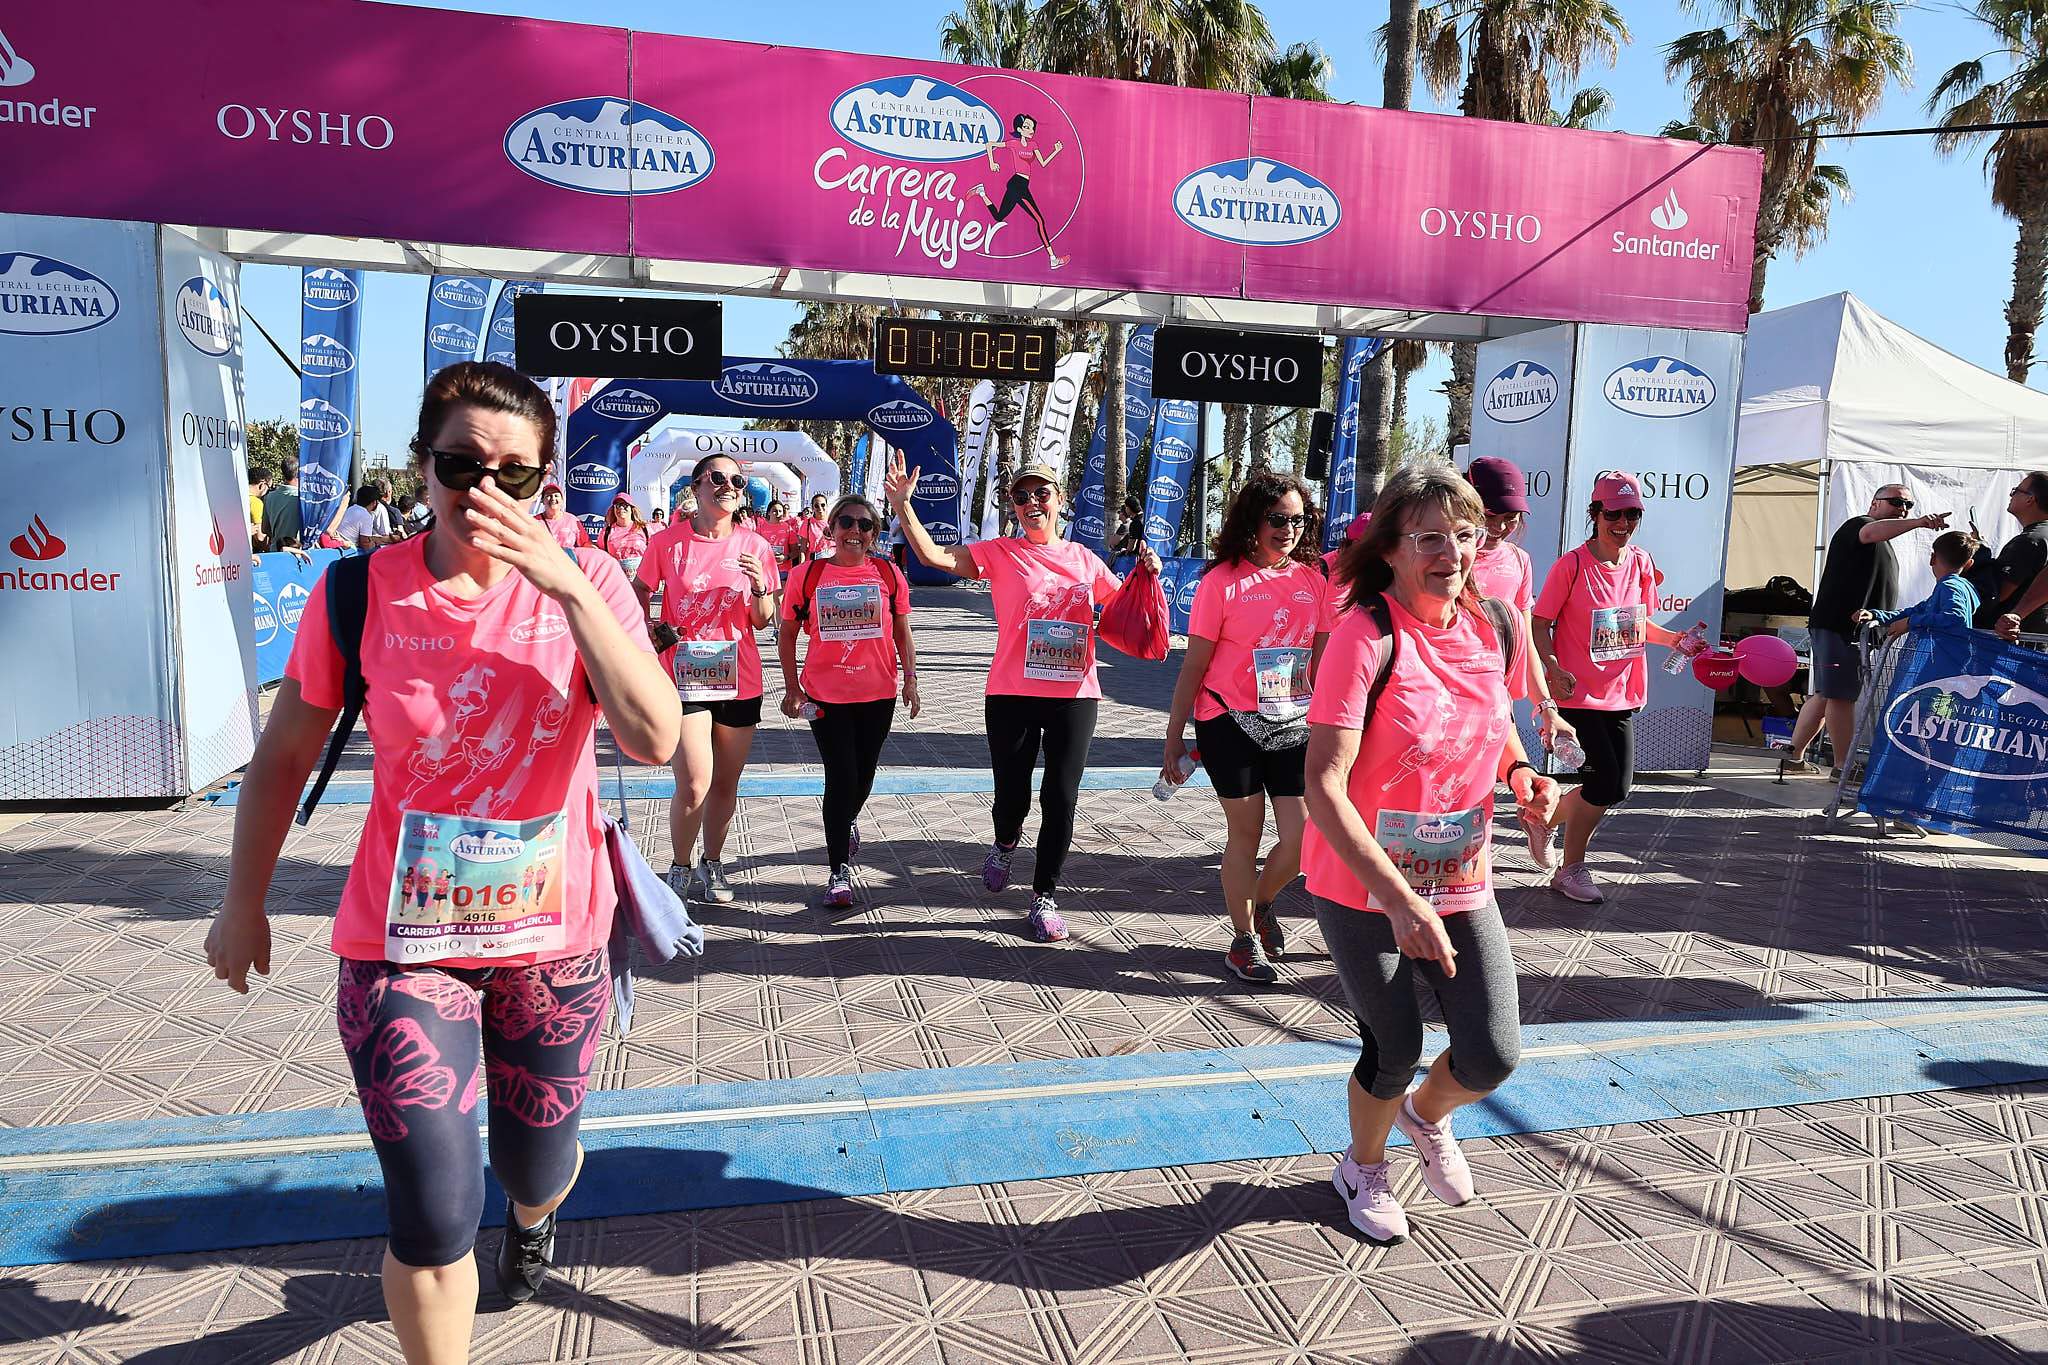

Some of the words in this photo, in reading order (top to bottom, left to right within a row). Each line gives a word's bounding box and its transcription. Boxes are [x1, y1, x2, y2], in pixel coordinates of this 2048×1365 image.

[871, 100, 926, 115] CENTRAL
[931, 107, 987, 120] LECHERA
[216, 103, 393, 150] OYSHO
[843, 101, 989, 144] ASTURIANA
[553, 127, 620, 141] CENTRAL
[520, 126, 699, 174] ASTURIANA
[813, 147, 957, 202] Carrera
[1213, 184, 1265, 197] CENTRAL
[1271, 189, 1324, 201] LECHERA
[1185, 184, 1328, 226] ASTURIANA
[849, 196, 876, 226] de
[881, 197, 900, 230] la
[895, 199, 1009, 270] Mujer
[1420, 207, 1541, 243] OYSHO
[1611, 230, 1720, 261] Santander
[37, 282, 98, 294] LECHERA
[437, 287, 483, 305] ASTURIANA
[549, 321, 694, 355] OYSHO
[889, 328, 1042, 371] 01:10:22
[1181, 351, 1299, 383] OYSHO
[720, 374, 810, 397] ASTURIANA
[1610, 376, 1707, 404] ASTURIANA
[1629, 376, 1664, 385] CENTRAL
[1668, 378, 1705, 386] LECHERA
[596, 400, 655, 413] ASTURIANA
[1487, 387, 1552, 411] ASTURIANA
[0, 405, 126, 445] SHO
[873, 411, 929, 423] ASTURIANA
[182, 411, 240, 452] OYSHO
[695, 434, 778, 454] OYSHO
[570, 473, 616, 485] ASTURIANA
[1593, 470, 1710, 500] SHO
[195, 562, 241, 588] Santander
[384, 632, 455, 651] OYSHO
[1048, 647, 1071, 658] 016
[692, 668, 716, 678] 016
[412, 829, 439, 840] SUMA
[1417, 829, 1461, 839] ASTURIANA
[455, 840, 521, 856] ASTURIANA
[1414, 858, 1458, 874] 016
[452, 884, 517, 907] 016
[397, 925, 441, 936] CARRERA
[444, 924, 457, 933] DE
[459, 924, 471, 933] LA
[474, 923, 506, 933] MUJER
[514, 916, 553, 930] VALENCIA
[464, 912, 496, 922] 4916
[405, 939, 461, 955] OYSHO
[496, 934, 545, 949] Santander
